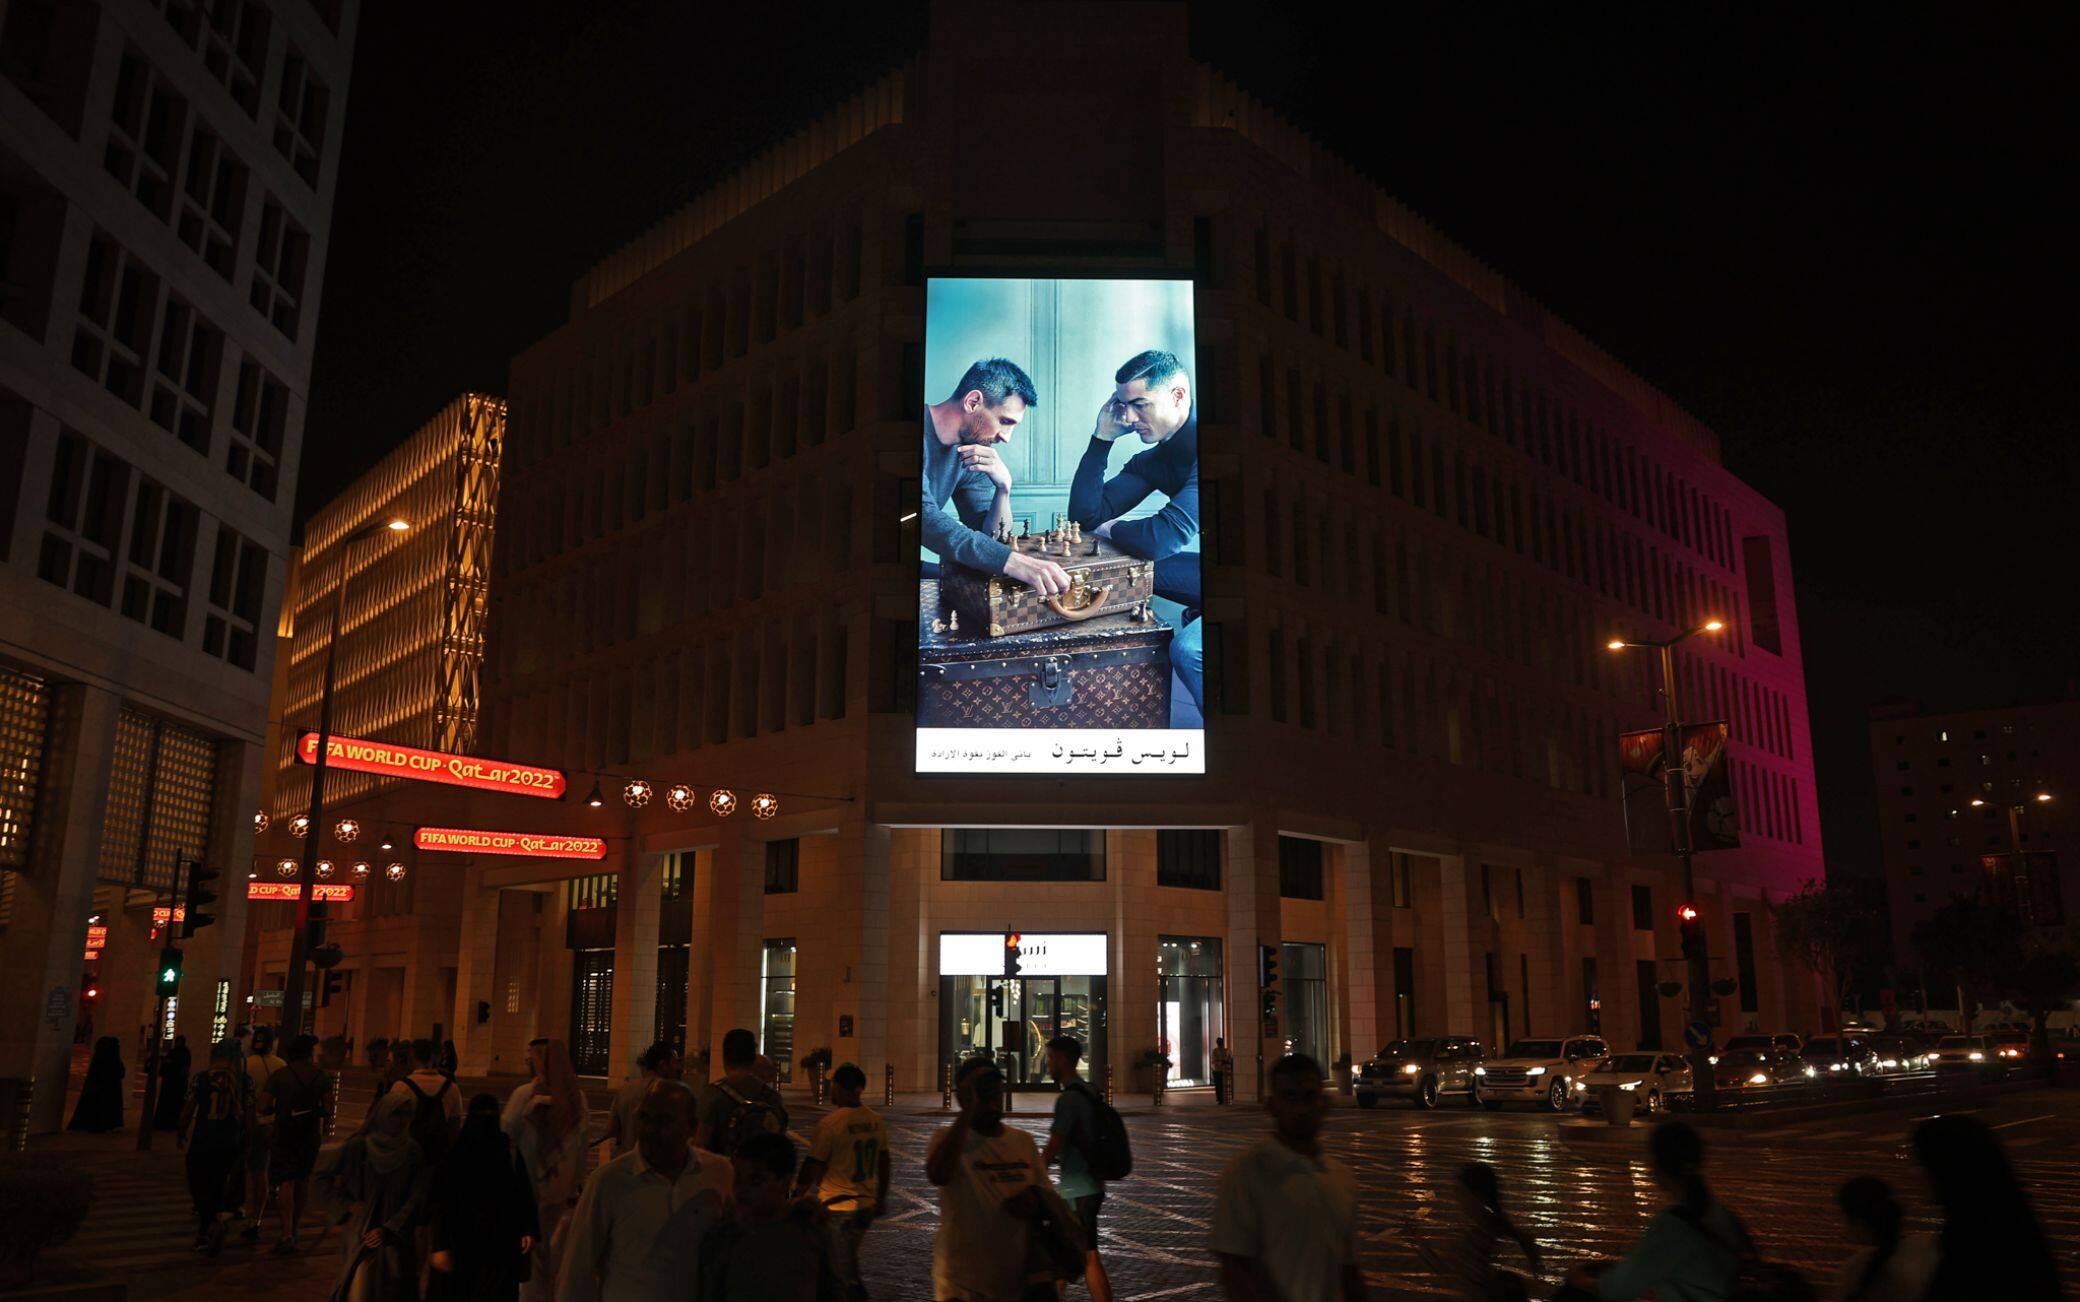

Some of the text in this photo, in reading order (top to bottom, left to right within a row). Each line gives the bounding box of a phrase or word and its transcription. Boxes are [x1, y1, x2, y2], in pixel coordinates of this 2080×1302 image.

[306, 739, 344, 758] FFA
[346, 744, 407, 767] WORLD
[420, 833, 447, 844] FIFA
[447, 834, 491, 847] WORLD
[492, 838, 515, 848] CUP
[259, 886, 277, 895] CUP
